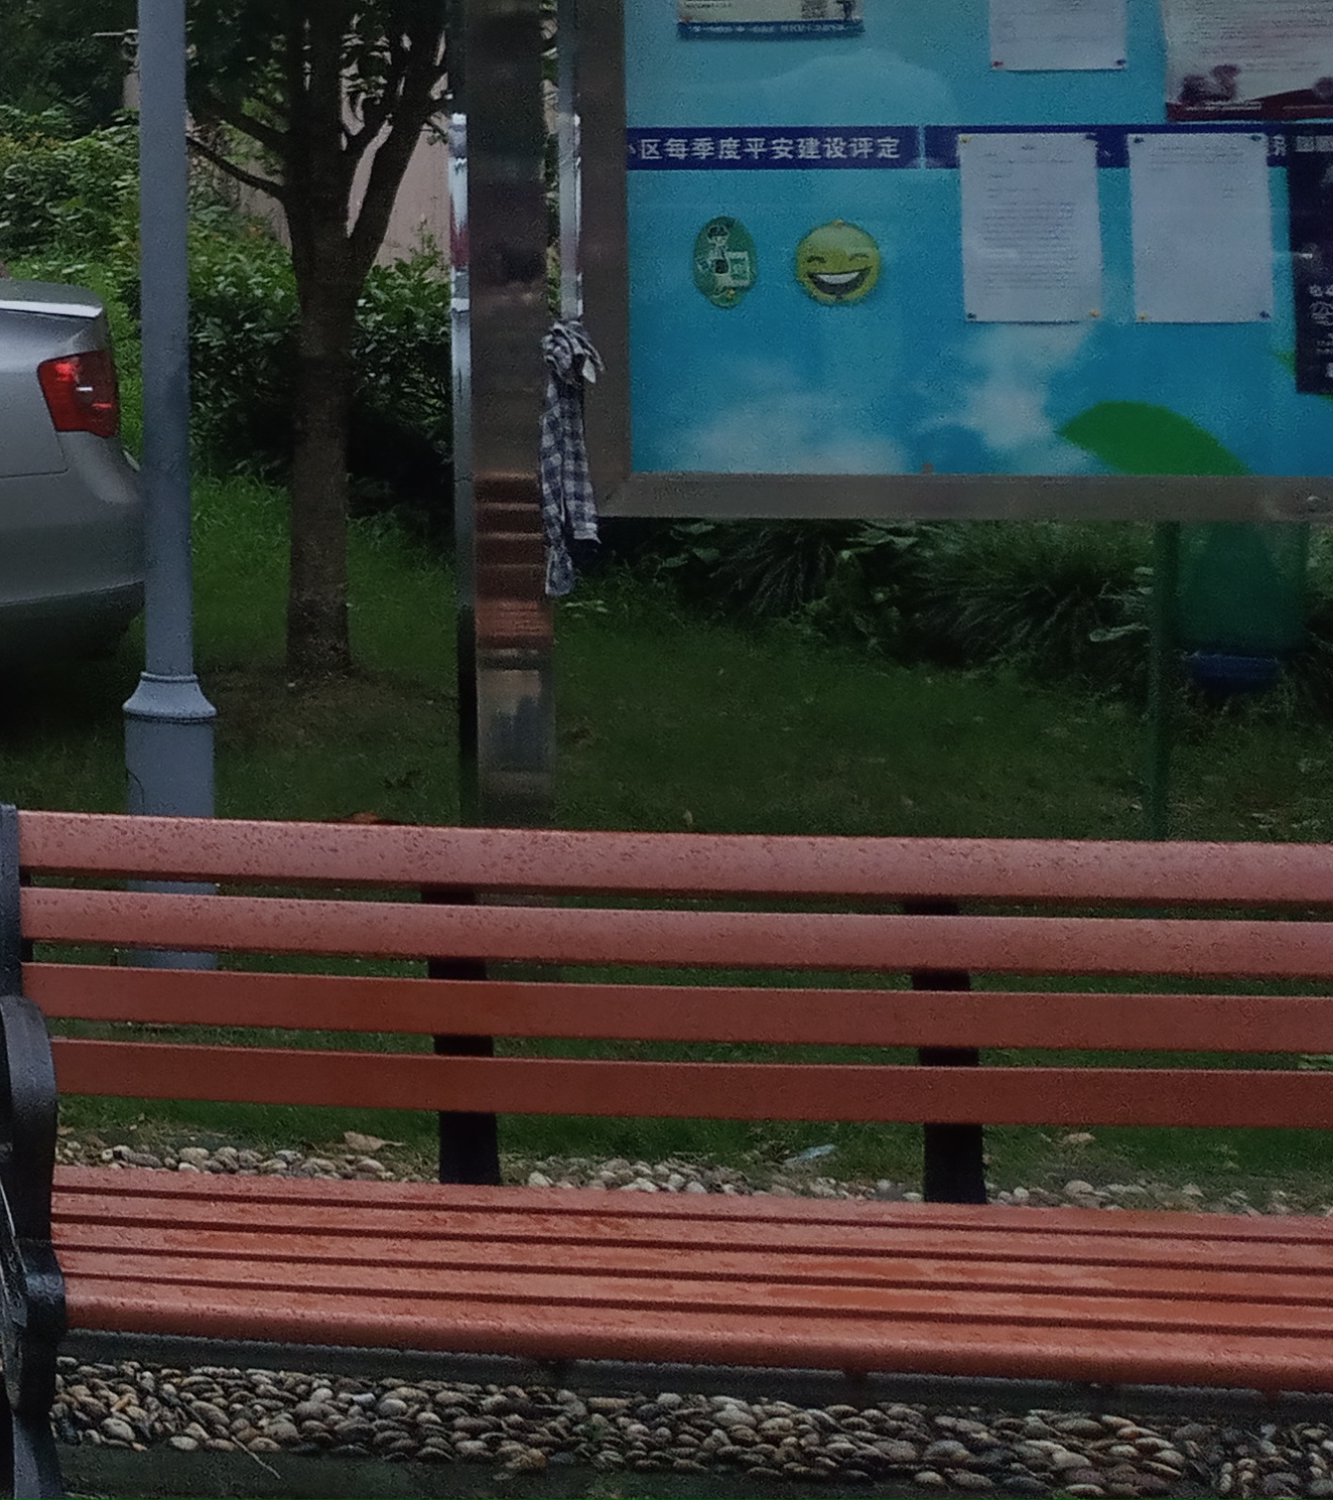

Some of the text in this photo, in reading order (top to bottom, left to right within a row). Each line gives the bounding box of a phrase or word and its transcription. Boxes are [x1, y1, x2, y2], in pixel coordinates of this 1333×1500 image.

[628, 135, 900, 160] 区每季度平安建设评定
